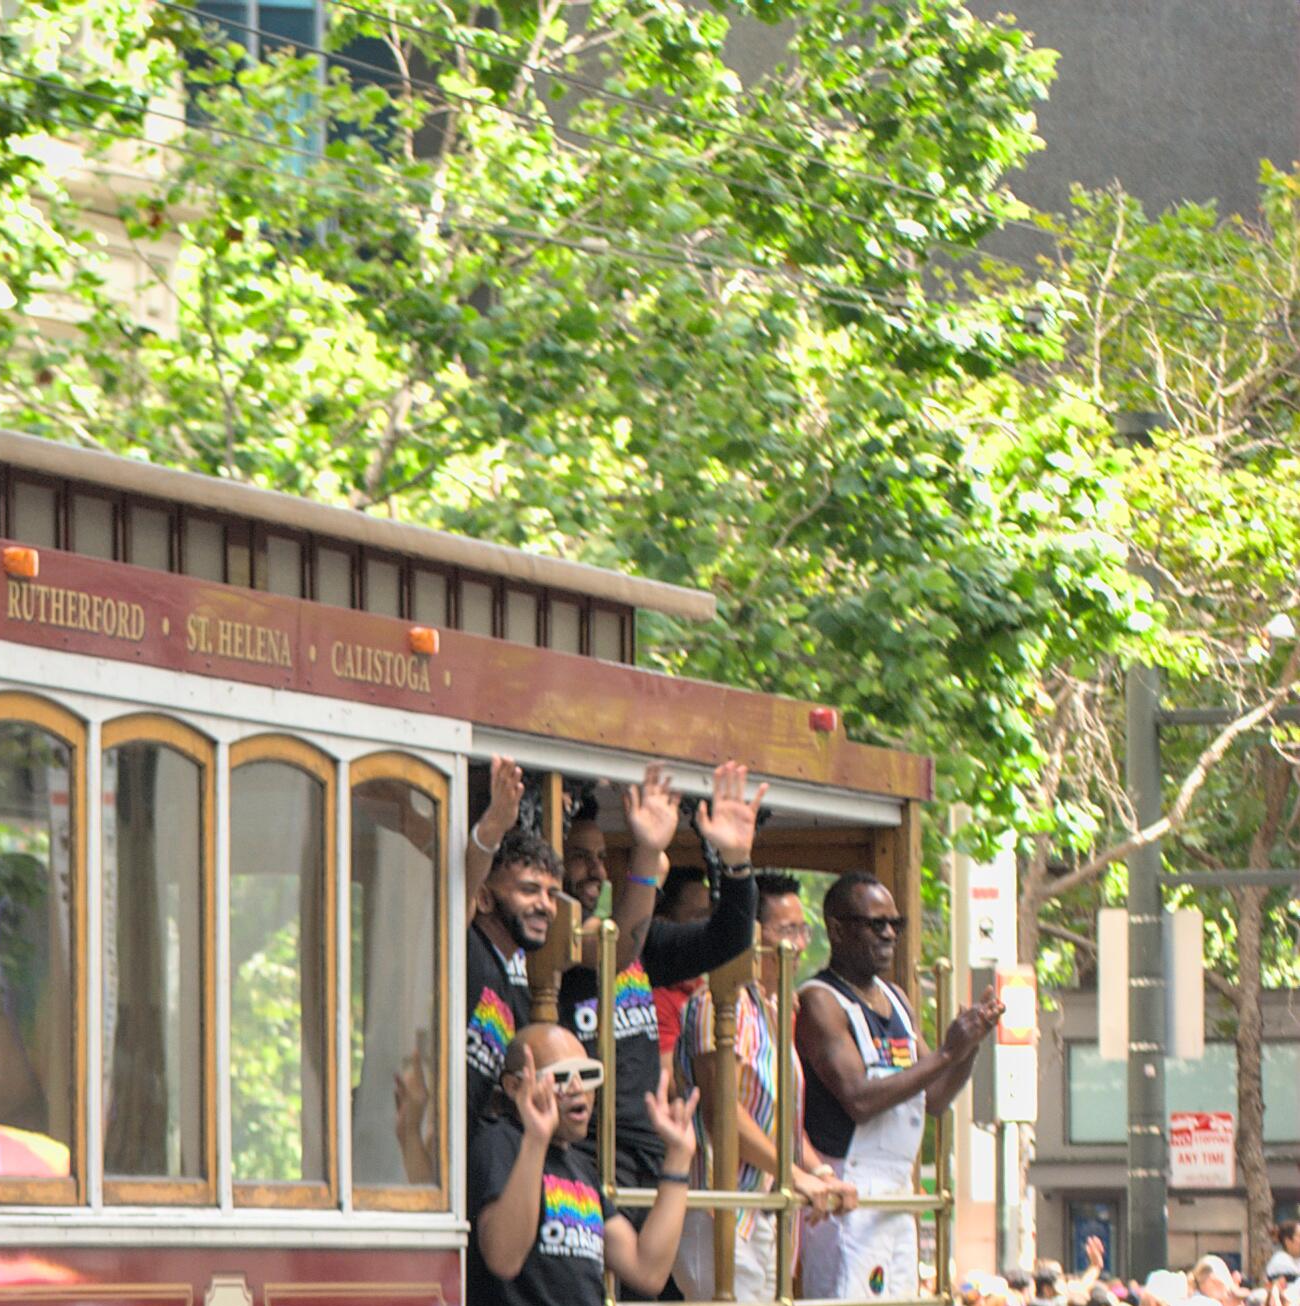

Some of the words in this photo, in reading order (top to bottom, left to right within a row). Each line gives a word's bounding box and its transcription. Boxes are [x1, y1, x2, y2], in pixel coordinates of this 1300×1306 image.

[7, 580, 145, 641] RUTHERFORD
[186, 614, 213, 652] ST.
[218, 622, 293, 668] HELENA
[331, 641, 431, 693] CALISTOGA
